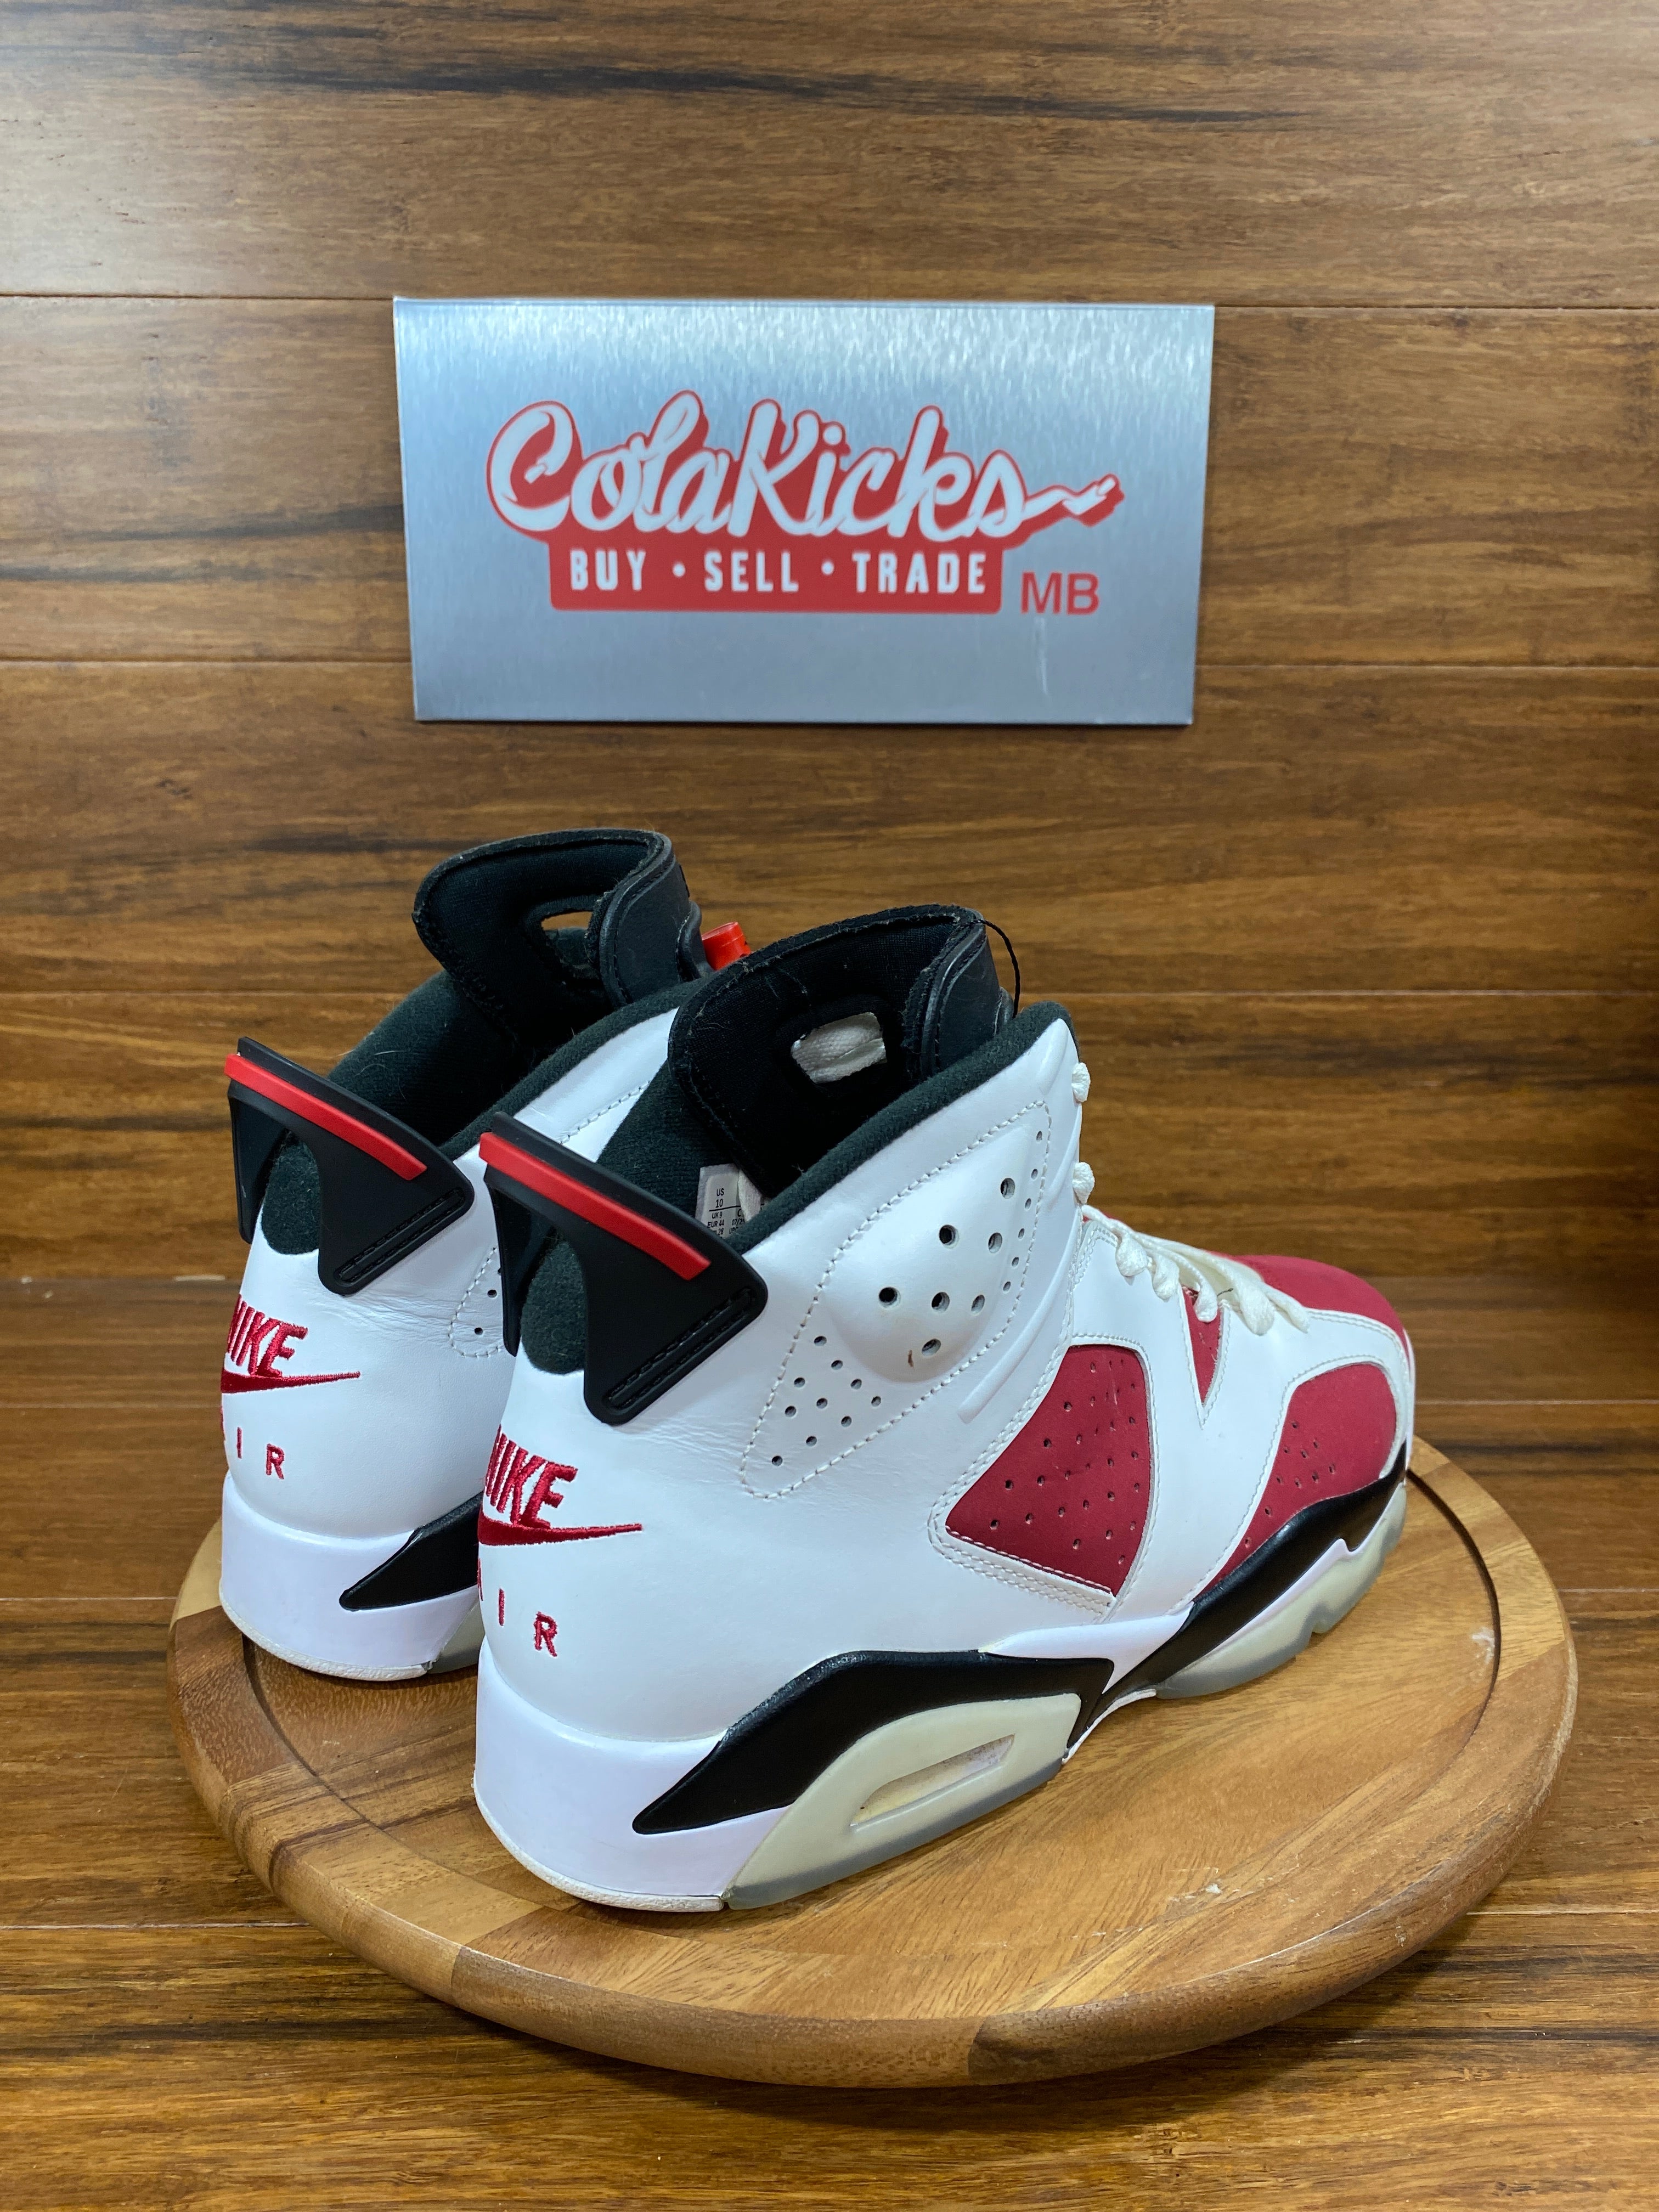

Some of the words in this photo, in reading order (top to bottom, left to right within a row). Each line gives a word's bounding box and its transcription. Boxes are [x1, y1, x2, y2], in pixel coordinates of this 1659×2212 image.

[487, 391, 1125, 542] ColaKicks
[569, 549, 646, 591] BUY
[704, 550, 799, 592] SELL
[853, 551, 987, 594] TRADE
[1020, 572, 1100, 616] MB
[715, 1198, 724, 1208] 10
[716, 1188, 725, 1197] US
